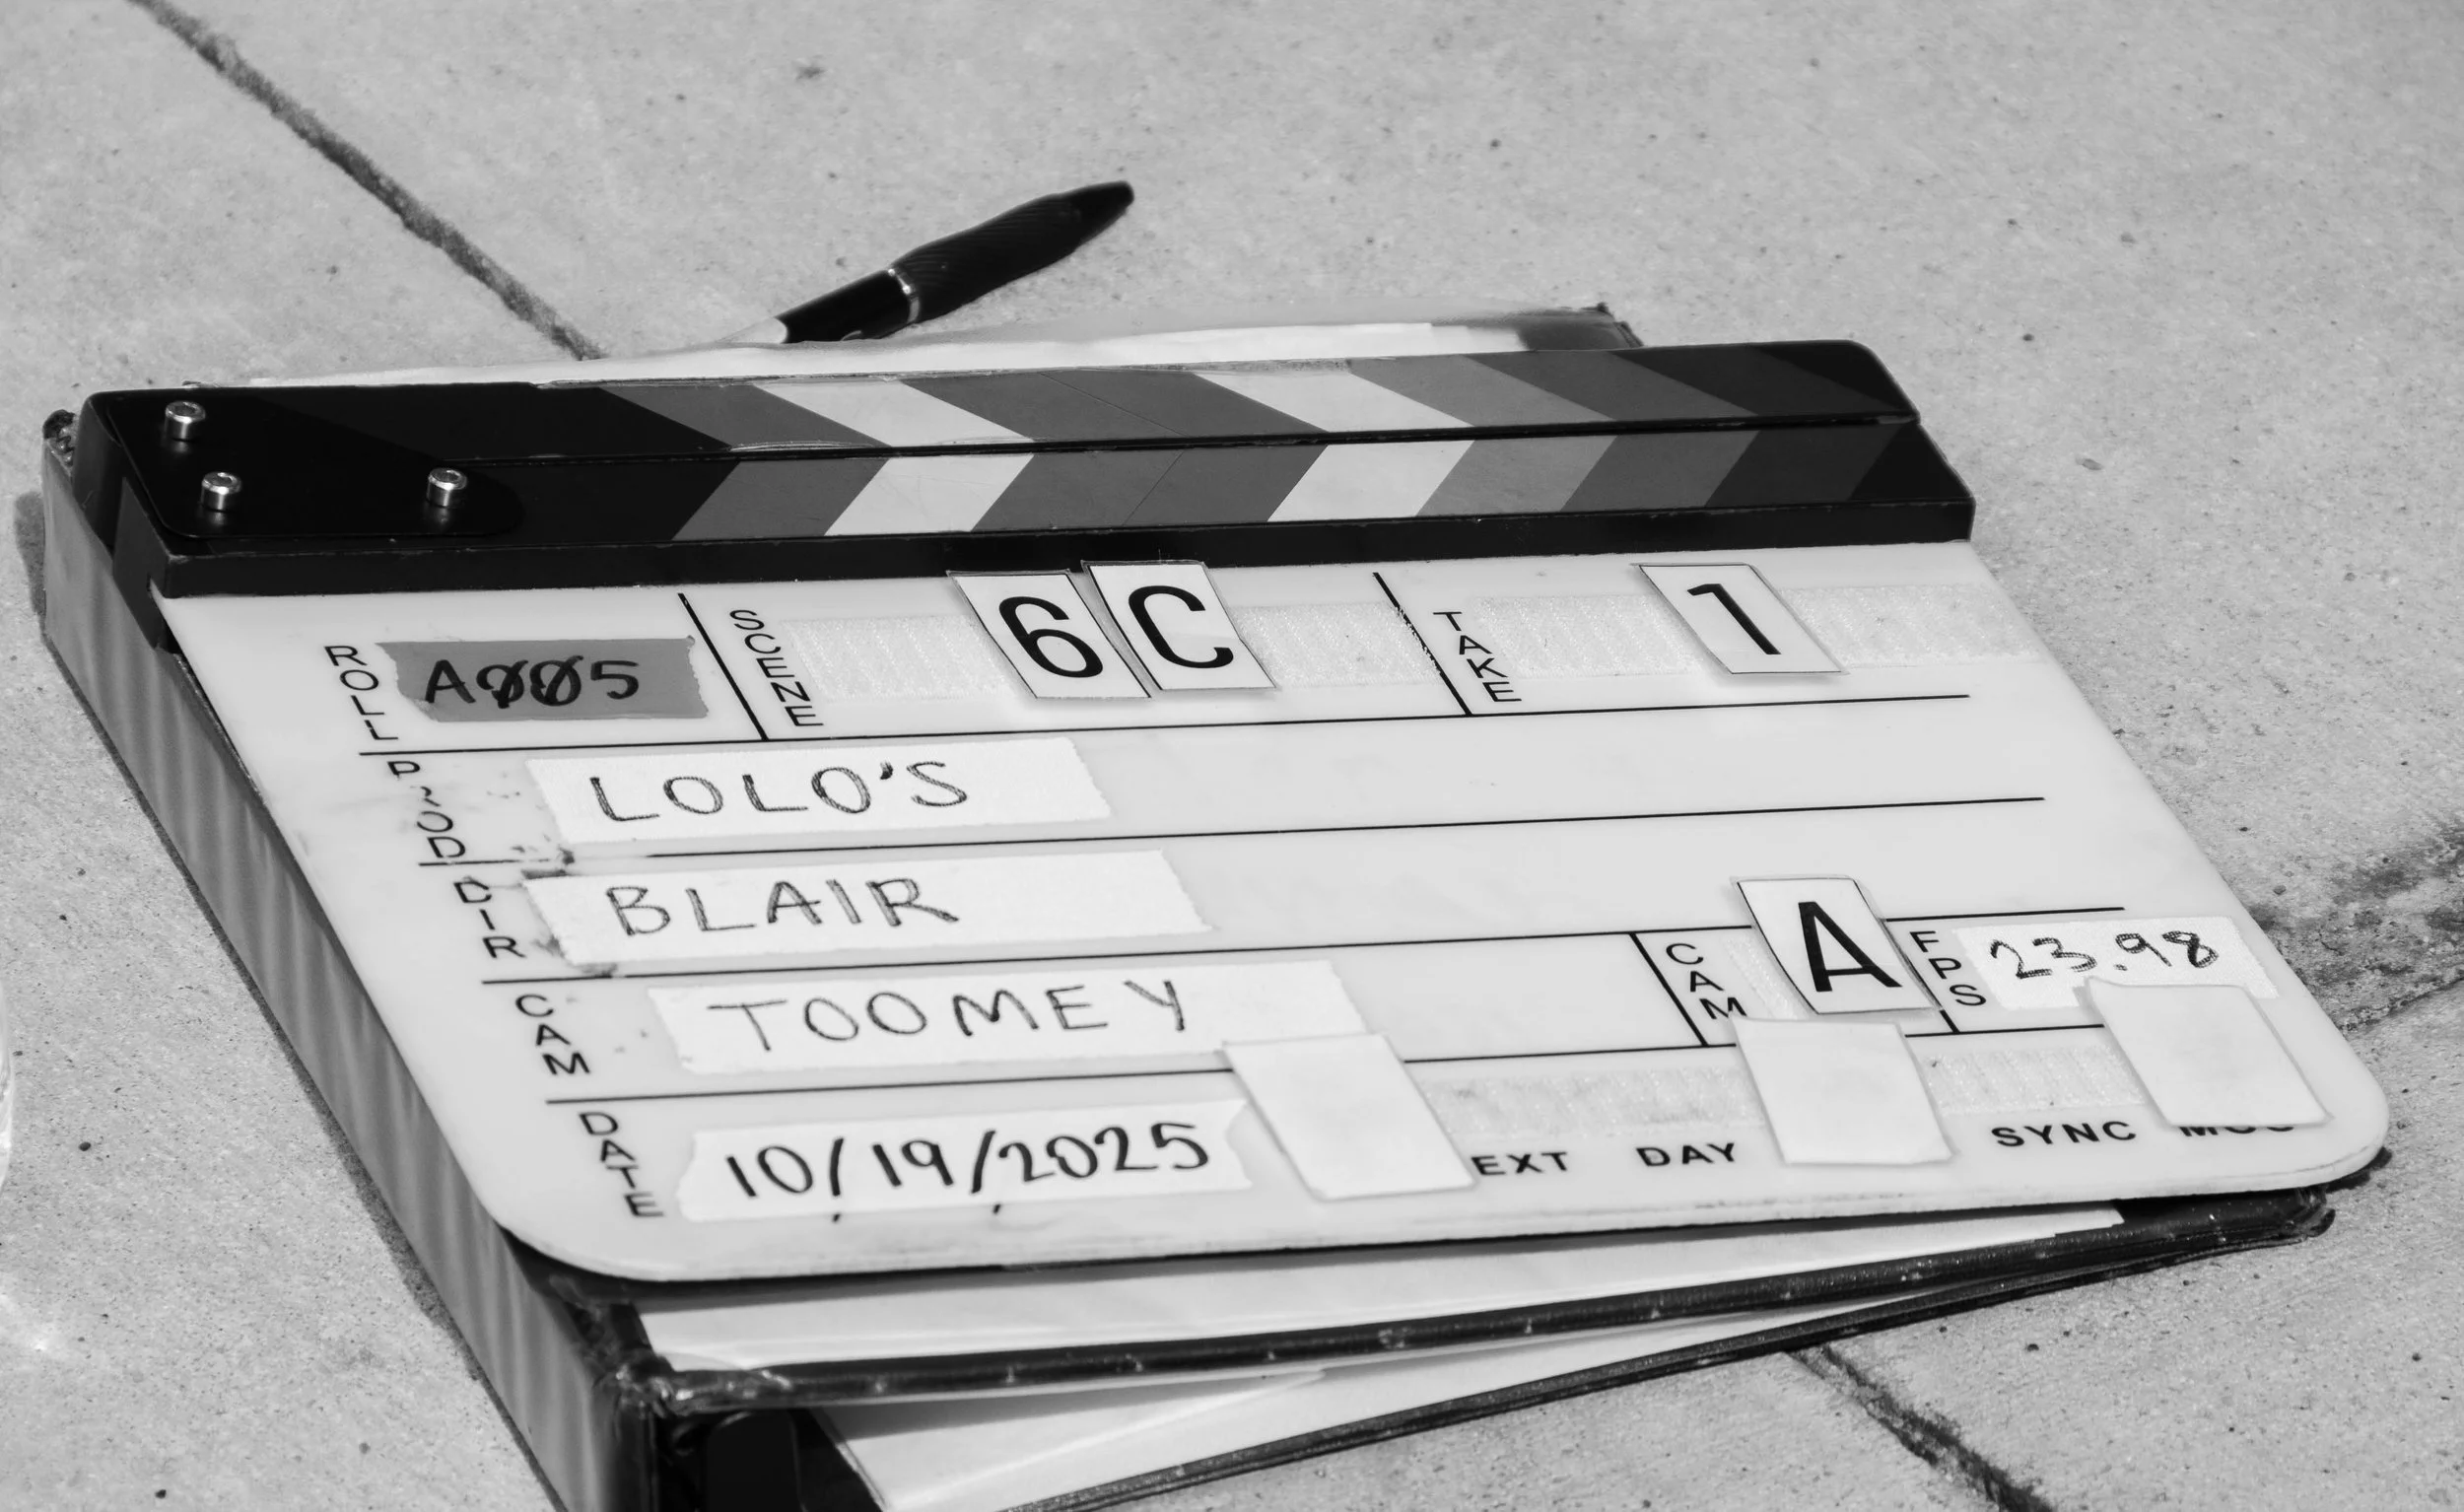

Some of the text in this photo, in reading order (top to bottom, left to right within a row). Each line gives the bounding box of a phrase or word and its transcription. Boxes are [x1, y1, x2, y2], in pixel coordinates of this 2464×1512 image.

[1432, 611, 1522, 703] TAKE
[1686, 583, 1782, 655] 1
[324, 645, 398, 740] ROLL
[729, 608, 824, 727] SCENE
[589, 761, 968, 822] LOLO'S
[452, 880, 525, 959] DIR
[605, 878, 960, 936] BLAIR
[1665, 942, 1748, 1019] CAM
[1797, 900, 1903, 993] A
[1908, 929, 1988, 1007] FPS
[1989, 930, 2219, 980] 23.98
[514, 994, 591, 1076] CAM
[707, 979, 1187, 1052] TOOMEY
[579, 1112, 664, 1217] DATE
[726, 1122, 1209, 1200] 10/19/2025
[1471, 1151, 1567, 1176] EXT
[1636, 1141, 1738, 1167] DAY
[1990, 1120, 2139, 1147] SYNC
